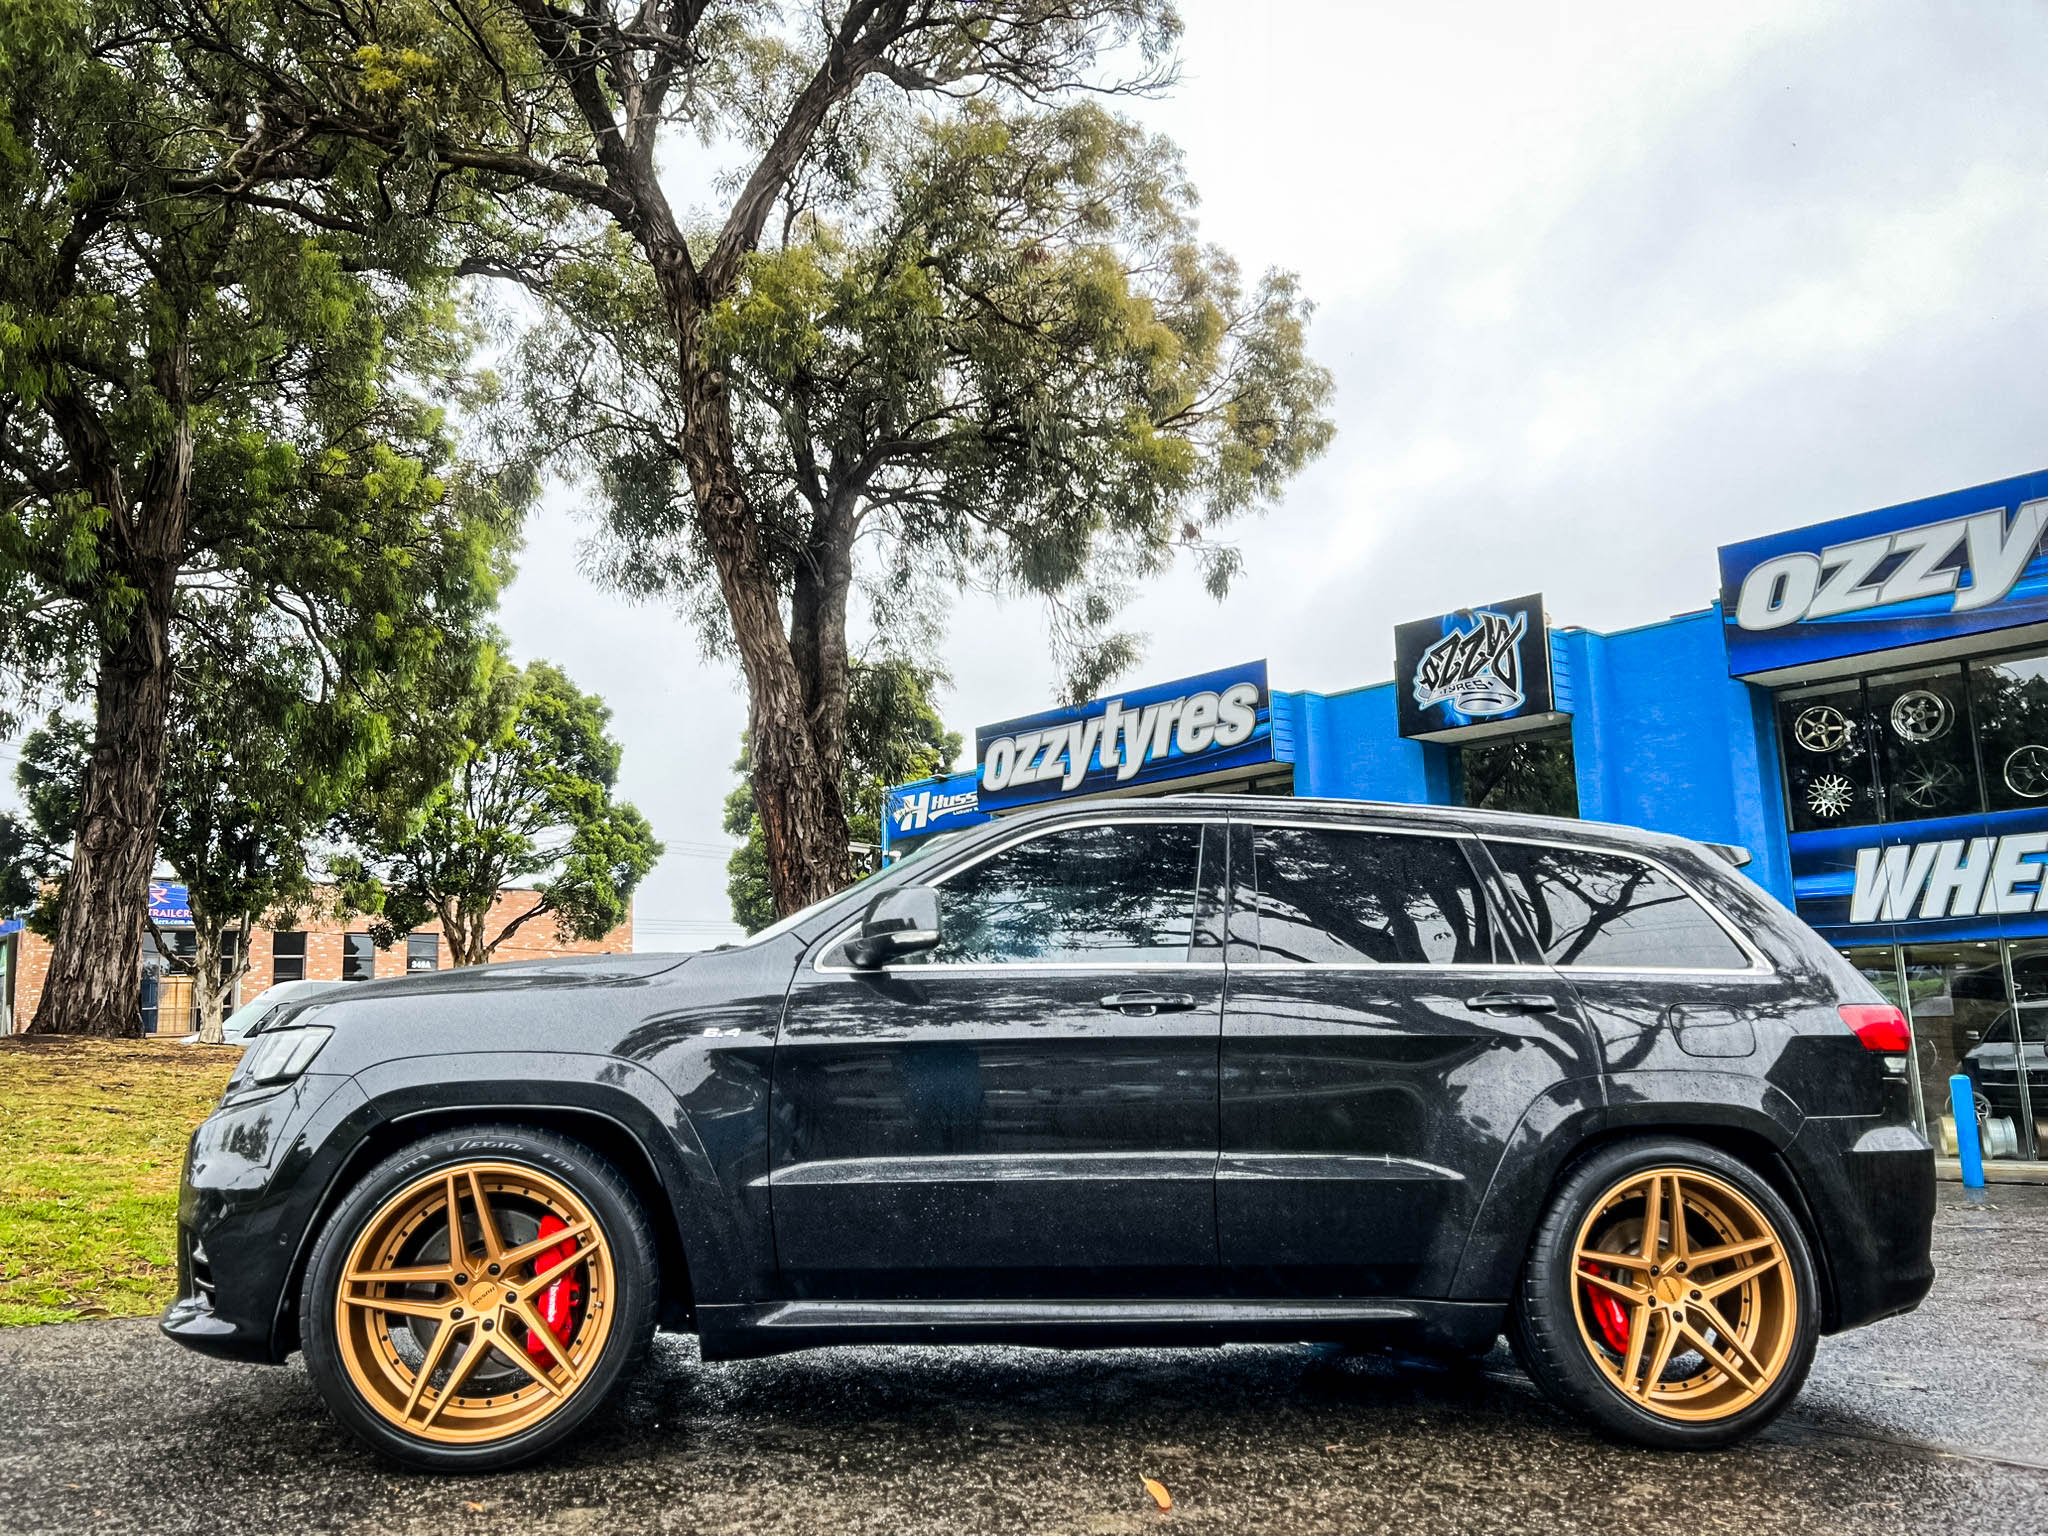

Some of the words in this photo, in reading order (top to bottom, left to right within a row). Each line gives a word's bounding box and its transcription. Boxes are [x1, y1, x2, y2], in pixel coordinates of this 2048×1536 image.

[1736, 497, 2048, 630] ozzy
[982, 682, 1259, 791] ozzytyres
[1443, 680, 1489, 694] TYRES
